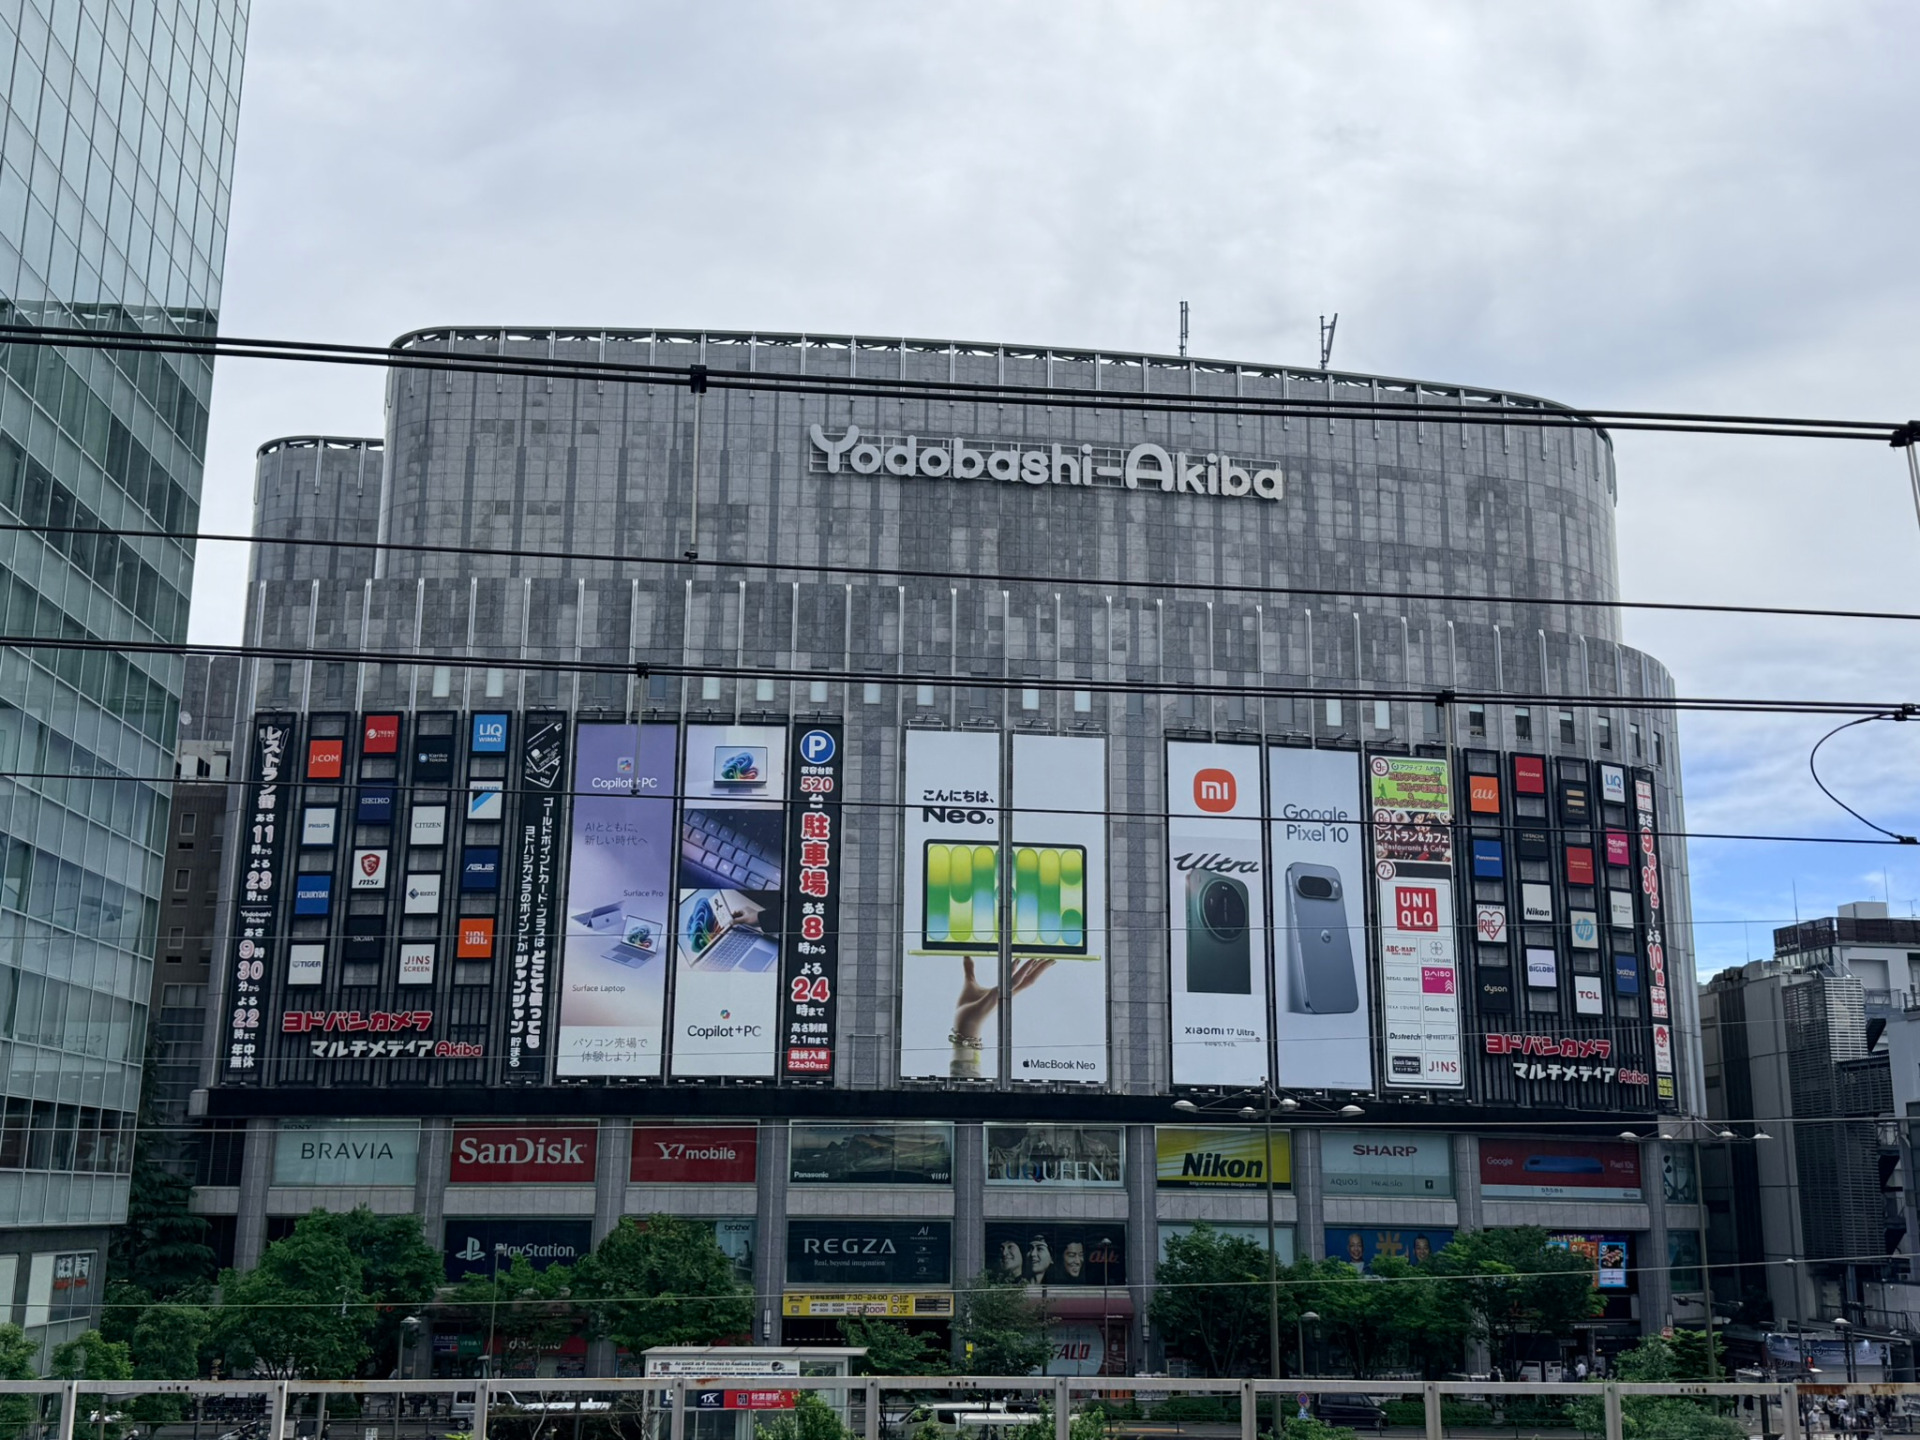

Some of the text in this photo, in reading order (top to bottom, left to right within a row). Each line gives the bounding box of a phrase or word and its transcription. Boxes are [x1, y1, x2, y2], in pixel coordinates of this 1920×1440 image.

[801, 777, 834, 792] 520
[1606, 774, 1622, 788] UQ
[808, 793, 825, 809] 台
[922, 789, 995, 803] こんにちは、
[1472, 789, 1497, 800] au
[255, 813, 275, 822] あさ
[1283, 803, 1348, 826] Google
[253, 824, 274, 843] 11
[584, 834, 648, 846] 新しい時代へ
[1286, 824, 1349, 843] Pixel 10
[800, 812, 831, 898] 駐車場
[250, 859, 271, 869] よる
[465, 863, 495, 871] ASUS
[246, 871, 272, 890] 23
[1400, 892, 1430, 908] UNI
[802, 902, 825, 914] あさ
[1525, 907, 1550, 917] Nikon
[1400, 911, 1434, 927] QLO
[243, 928, 265, 938] あさ
[801, 915, 824, 940] 8
[798, 942, 826, 955] 時から
[1386, 945, 1417, 953] ABC-MART
[237, 960, 264, 980] 30
[299, 960, 321, 968] TIGER
[800, 962, 822, 975] よる
[1528, 965, 1555, 973] BIGLOBE
[1424, 970, 1451, 978] DAISO
[572, 984, 626, 994] Surface Laptop
[791, 976, 831, 1003] 24
[1484, 983, 1508, 994] dyson
[1578, 990, 1600, 1000] TCL
[237, 996, 258, 1006] よる
[796, 1004, 825, 1017] 時まで
[233, 1009, 260, 1028] 22
[282, 1010, 433, 1032] ヨドバシカメラ
[790, 1023, 828, 1033] 高さ制限
[1226, 1027, 1235, 1036] 17
[1236, 1027, 1256, 1037] Ultra
[310, 1040, 484, 1058] マルチメディア Akiba
[573, 1037, 648, 1049] パソコン売場で
[1486, 1033, 1611, 1059] ヨドバシカメラ
[790, 1051, 827, 1061] 最終入庫
[1030, 1059, 1096, 1071] MacBook Neo
[1513, 1062, 1650, 1086] マルチメディア Akiba
[300, 1141, 394, 1160] BRAVIA
[458, 1137, 585, 1165] SanDisk
[1352, 1144, 1418, 1157] SHARP
[1182, 1151, 1264, 1179] Nikon
[1486, 1155, 1514, 1167] Google
[794, 1171, 829, 1179] Panasonic
[724, 1223, 751, 1232] brother
[803, 1238, 897, 1255] REGZA
[831, 1259, 851, 1267] beyond
[852, 1258, 886, 1267] imagination
[700, 1392, 720, 1403] TX
